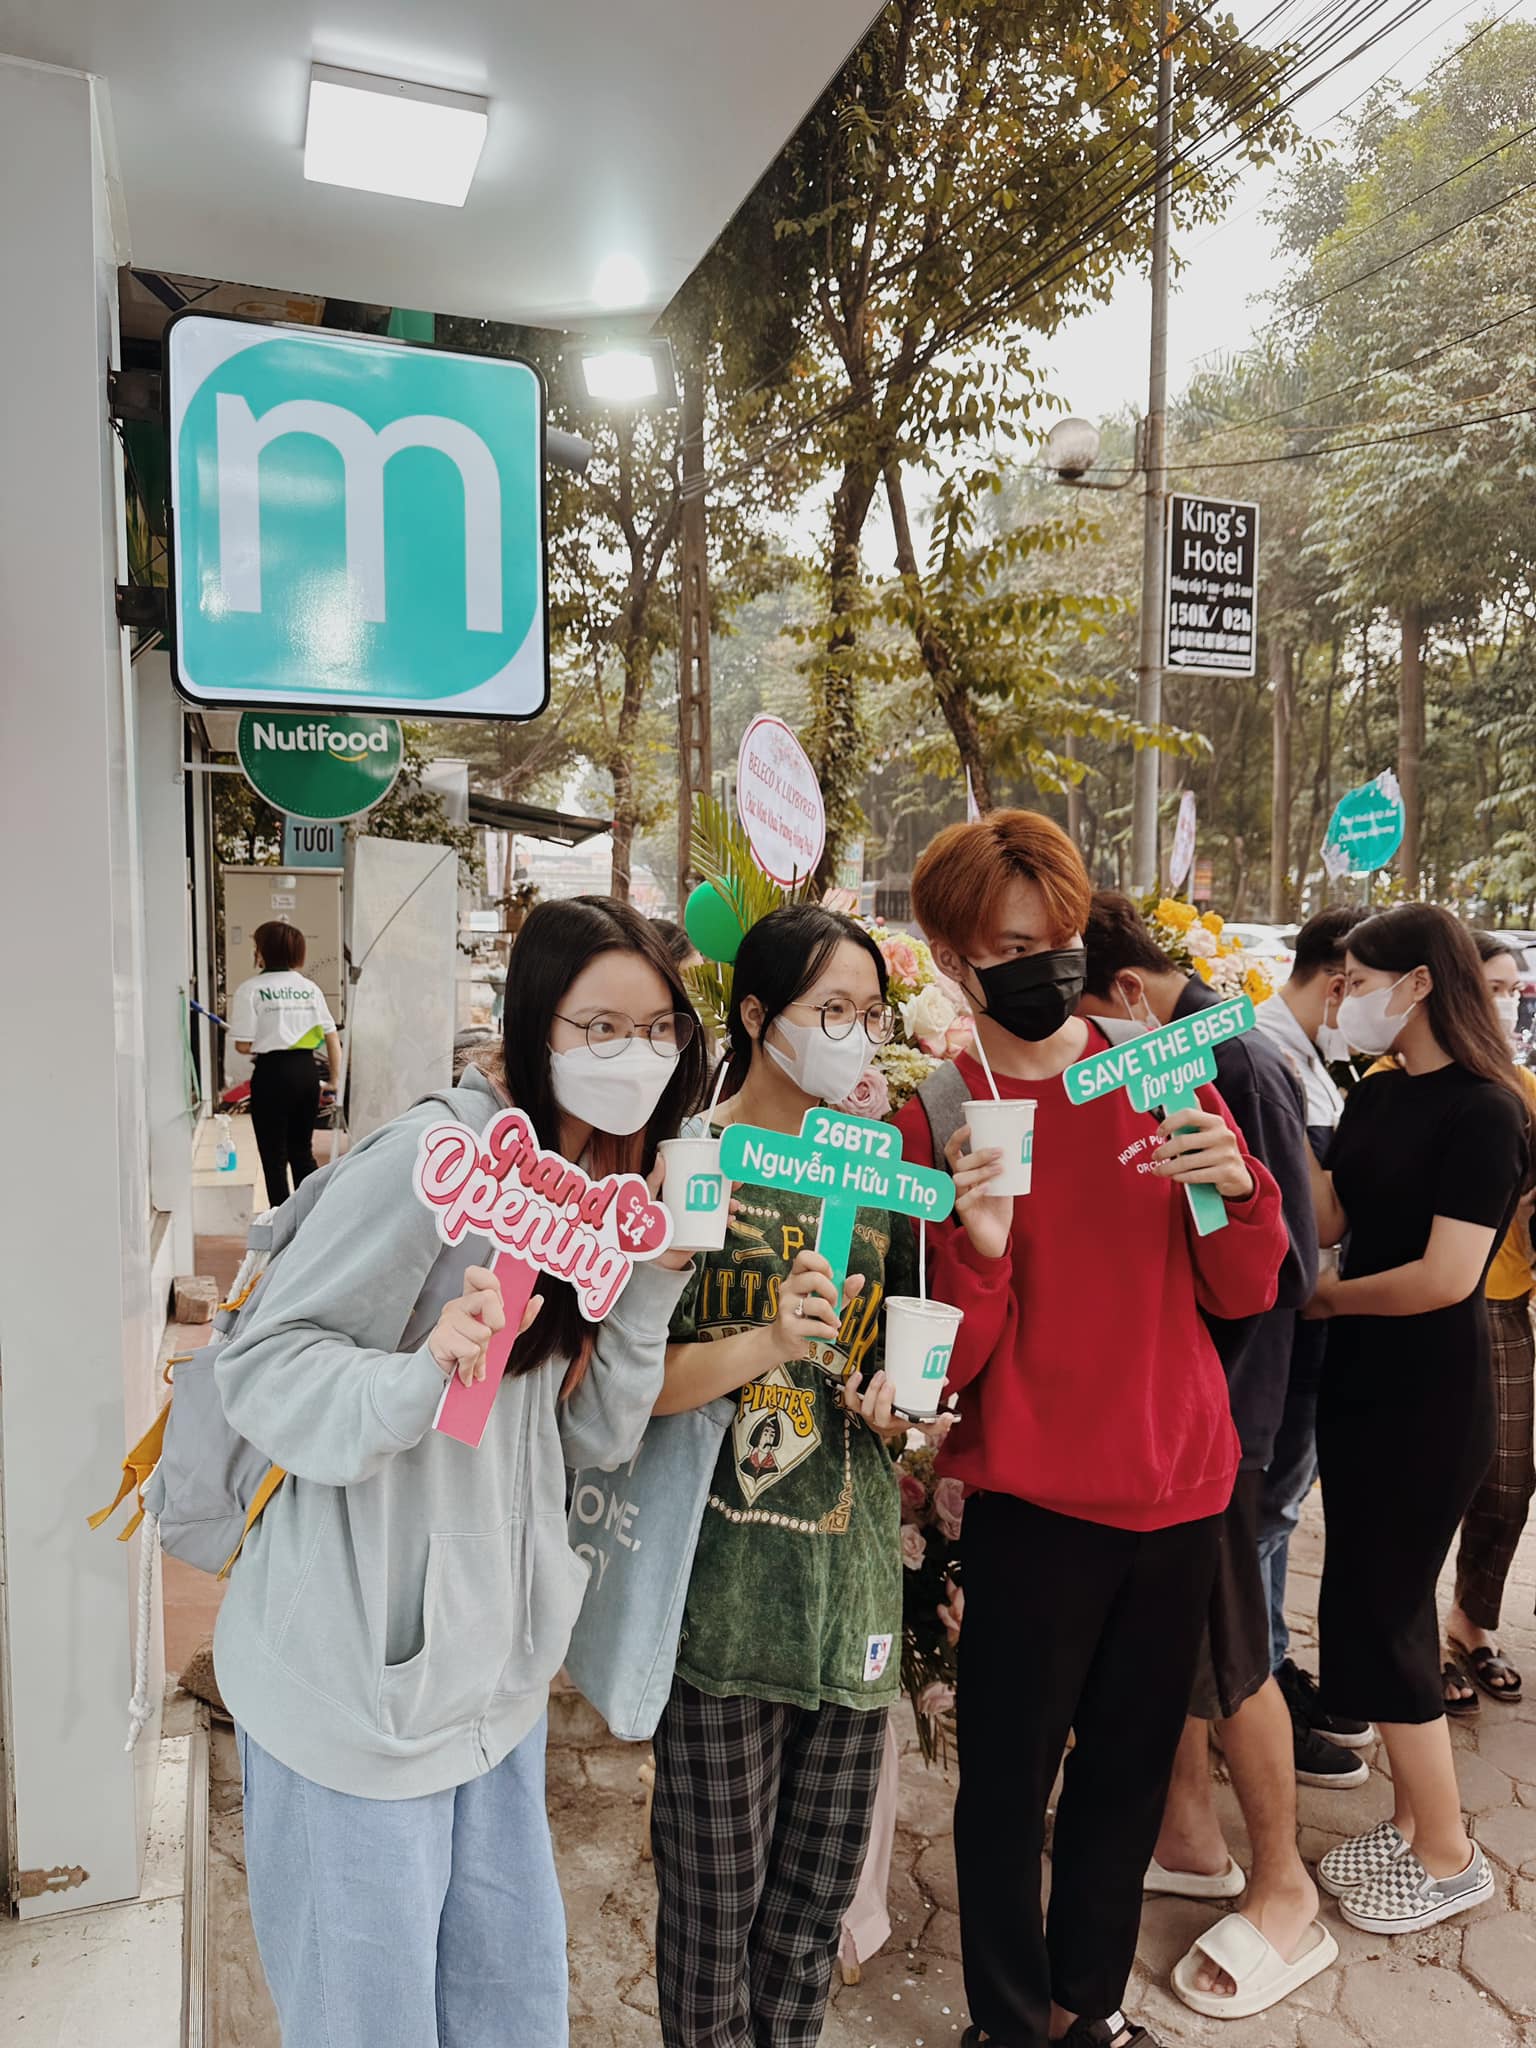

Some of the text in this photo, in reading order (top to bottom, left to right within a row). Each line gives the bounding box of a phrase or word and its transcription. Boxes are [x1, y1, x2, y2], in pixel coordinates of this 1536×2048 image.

[215, 392, 503, 634] m
[1181, 500, 1248, 545] King's
[1183, 538, 1243, 576] Hotel
[252, 722, 389, 753] Nutifood
[293, 825, 335, 853] TƯƠI
[1077, 1002, 1245, 1097] SAVE THE BEST
[1141, 1056, 1206, 1109] for you
[813, 1118, 892, 1159] 26BT2
[1117, 1137, 1148, 1166] HONEY
[480, 1114, 619, 1231] Grand
[689, 1179, 719, 1205] m
[741, 1140, 938, 1212] Nguyễn Hữu Thọ
[420, 1125, 630, 1319] Opening
[619, 1211, 647, 1247] 14
[781, 1225, 805, 1261] P
[738, 1382, 816, 1437] PIRATES
